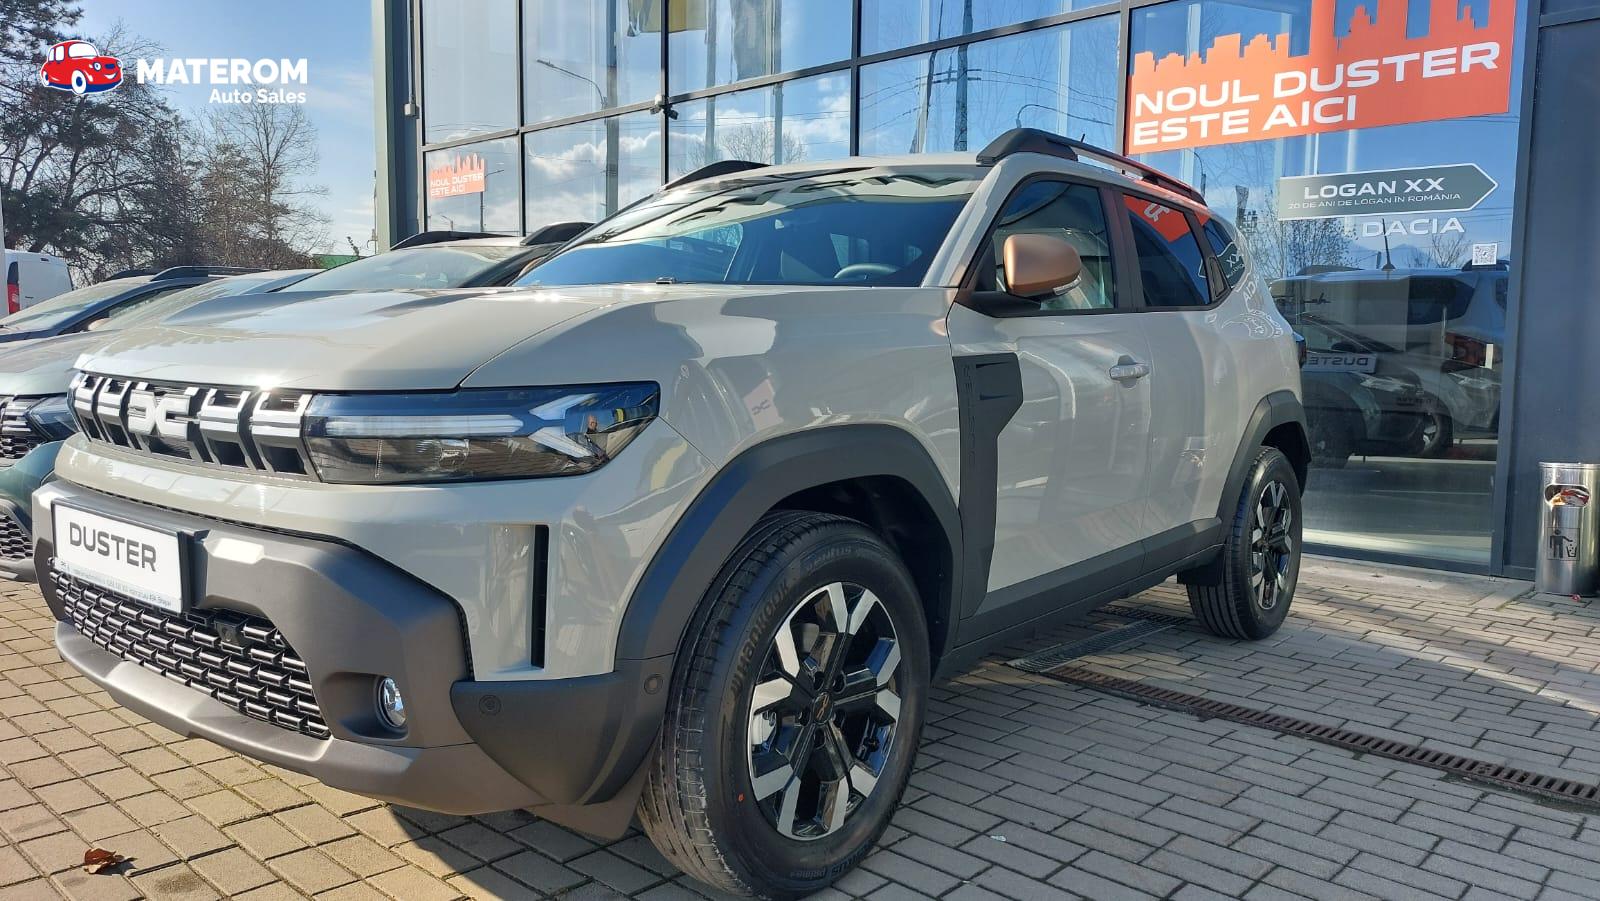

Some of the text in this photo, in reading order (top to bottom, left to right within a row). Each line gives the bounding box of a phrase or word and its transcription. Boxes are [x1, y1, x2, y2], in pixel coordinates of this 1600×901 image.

[1134, 41, 1500, 117] NOUL DUSTER
[1132, 95, 1357, 147] ESTE AICI
[430, 174, 483, 188] NOUL DUSTER
[430, 187, 449, 197] ESTE
[1304, 177, 1445, 200] LOGAN XX
[1302, 201, 1317, 209] DE
[1354, 197, 1392, 206] LOGAN
[1362, 217, 1465, 238] DACIA
[69, 521, 157, 572] DUSTER
